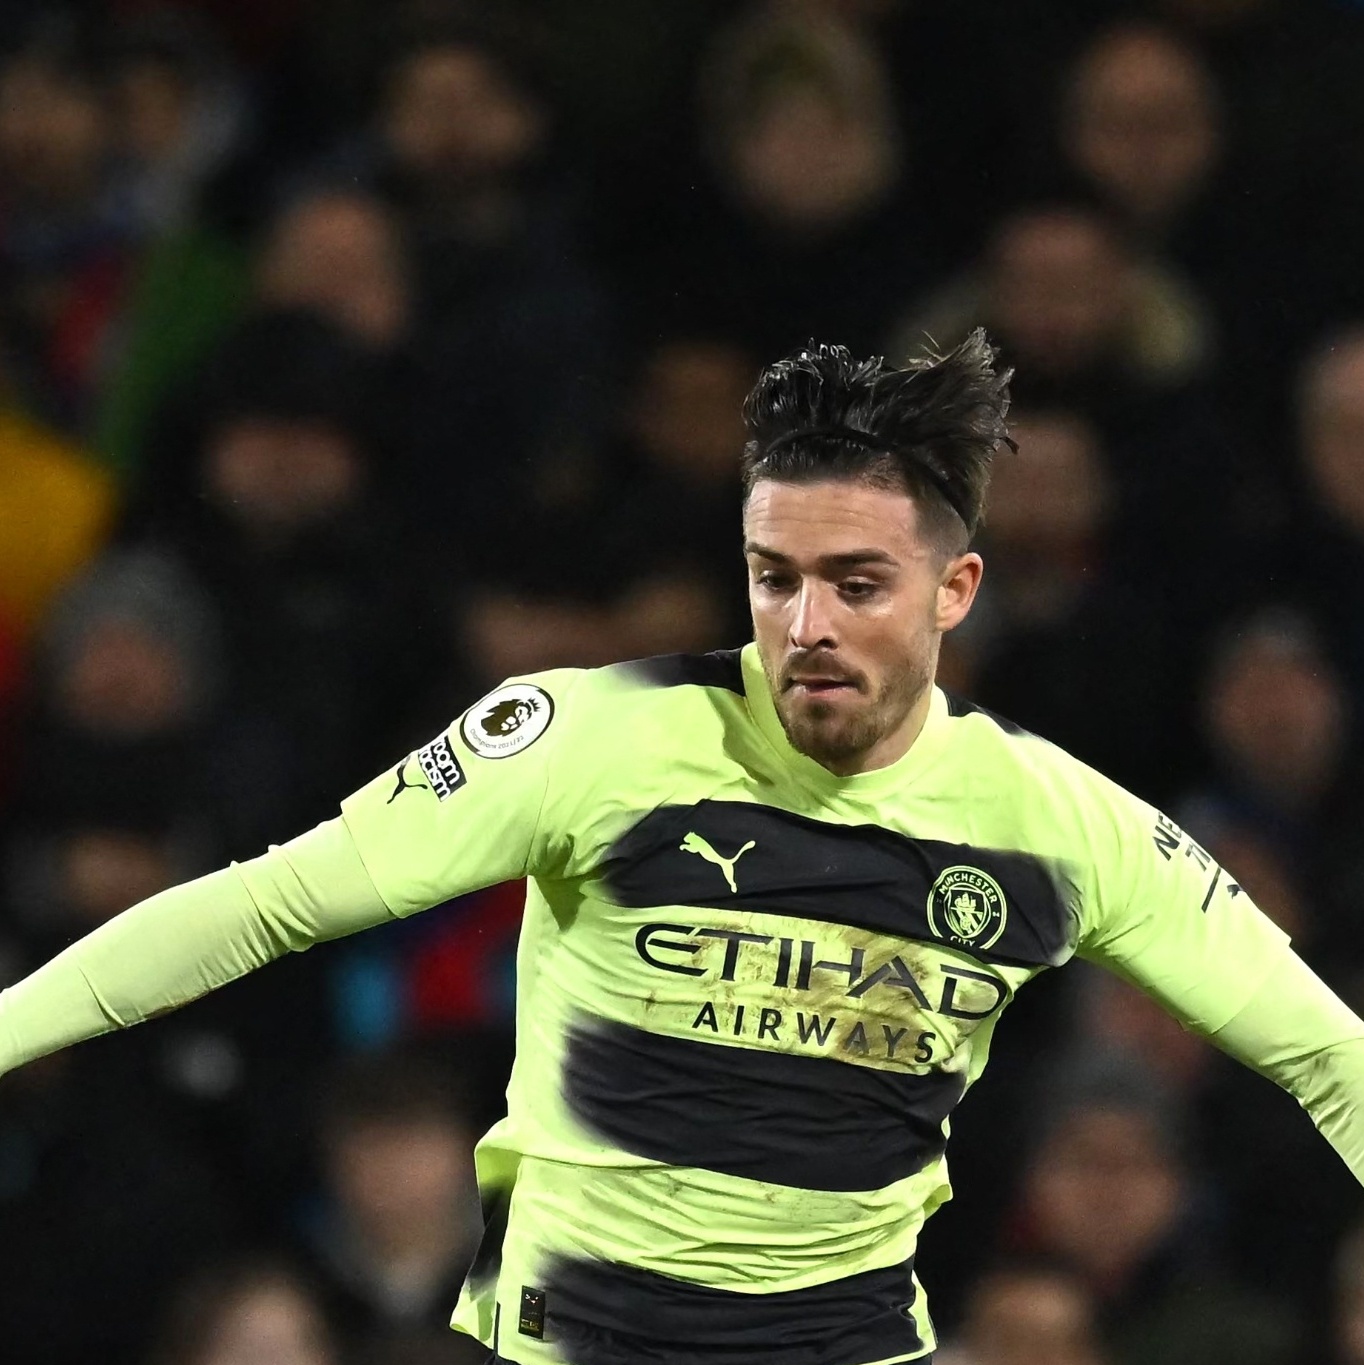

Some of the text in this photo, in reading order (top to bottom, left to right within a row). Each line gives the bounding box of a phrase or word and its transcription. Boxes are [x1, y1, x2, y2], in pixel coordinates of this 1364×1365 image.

[938, 872, 998, 904] MNCHESTER
[635, 922, 1008, 1021] ETIHAD
[692, 1001, 937, 1064] AIRWAYS
